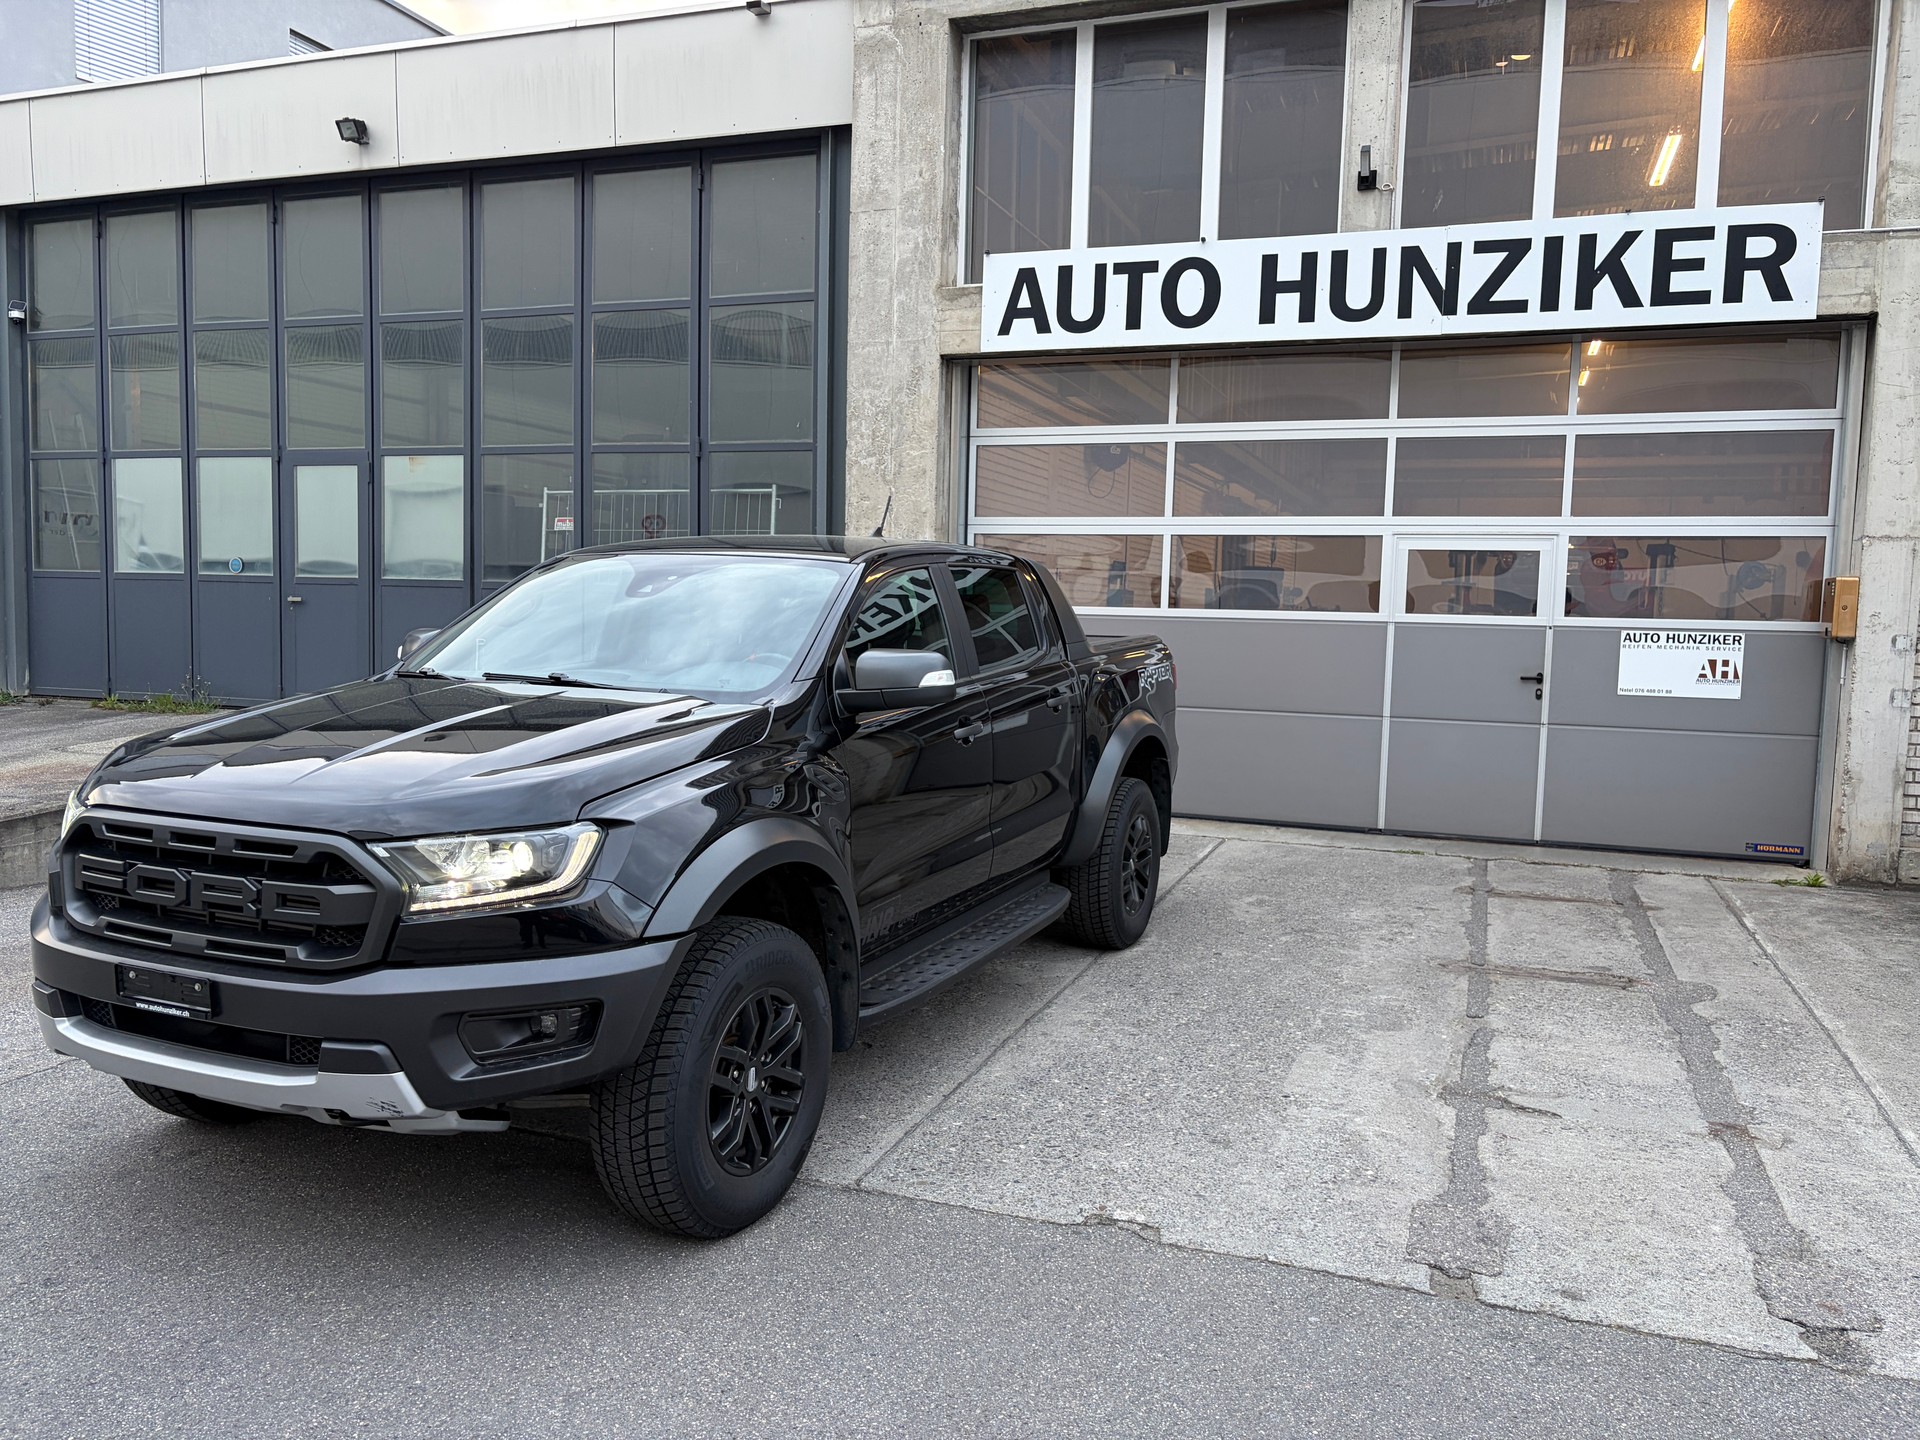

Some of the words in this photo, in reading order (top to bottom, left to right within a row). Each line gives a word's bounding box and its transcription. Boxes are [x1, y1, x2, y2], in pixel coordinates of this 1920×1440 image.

[997, 256, 1222, 336] AUTO
[1258, 223, 1798, 325] HUNZIKER
[1623, 633, 1660, 644] AUTO
[1666, 633, 1743, 646] HUNZIKER
[74, 852, 377, 928] FORD
[135, 1002, 190, 1018] www.autohunziker.ch
